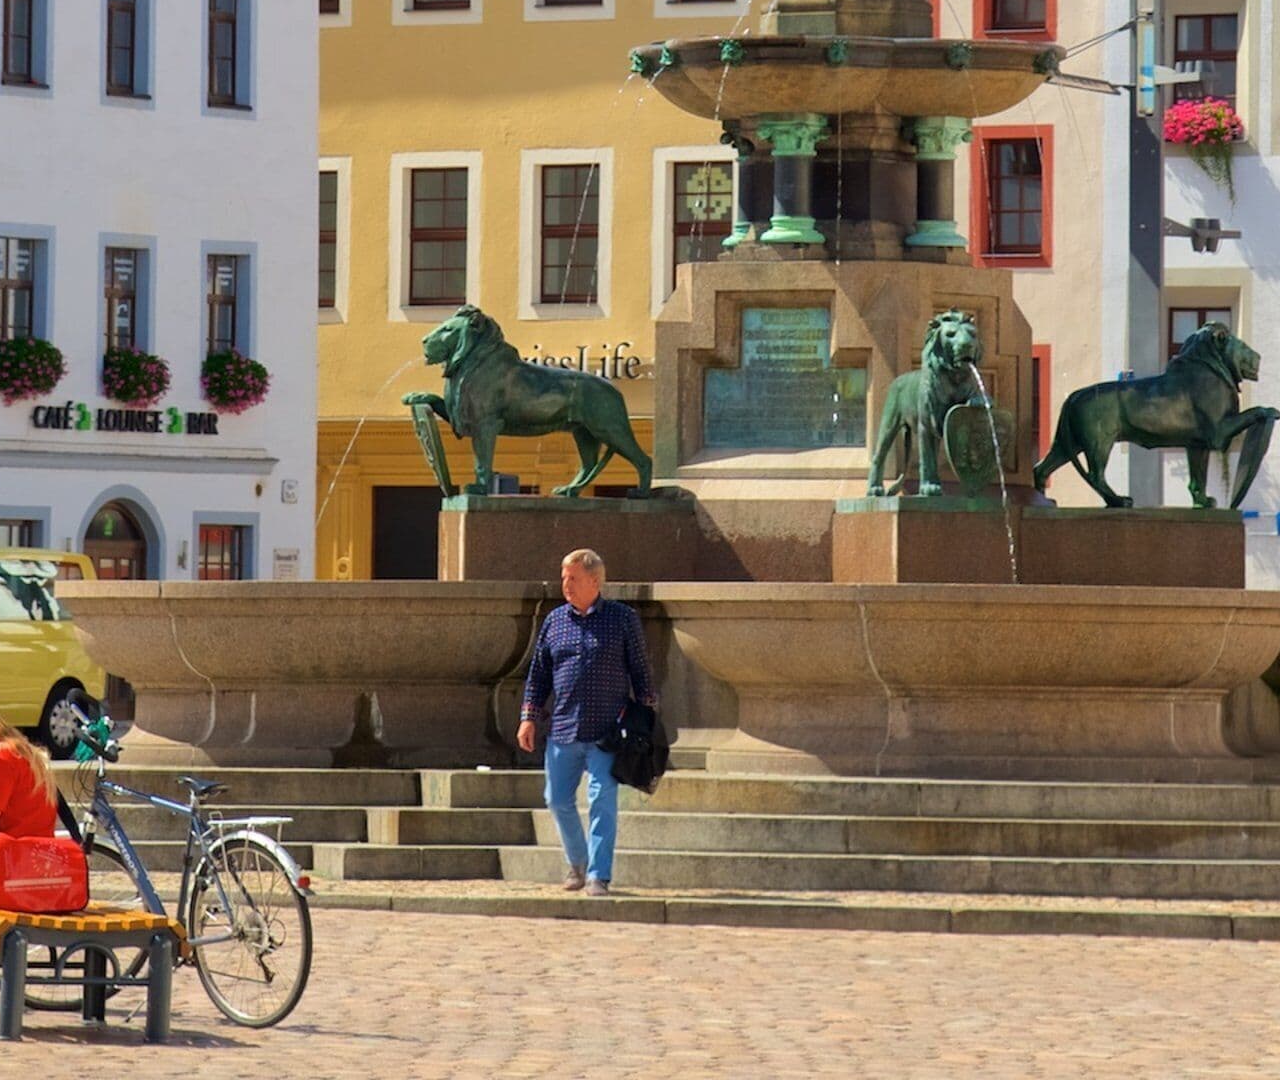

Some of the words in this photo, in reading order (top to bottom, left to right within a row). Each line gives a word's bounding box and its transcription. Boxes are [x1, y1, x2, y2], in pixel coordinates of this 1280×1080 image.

[31, 400, 73, 430] CAFÉ
[96, 408, 163, 433] LOUNGE
[186, 412, 219, 435] BAR
